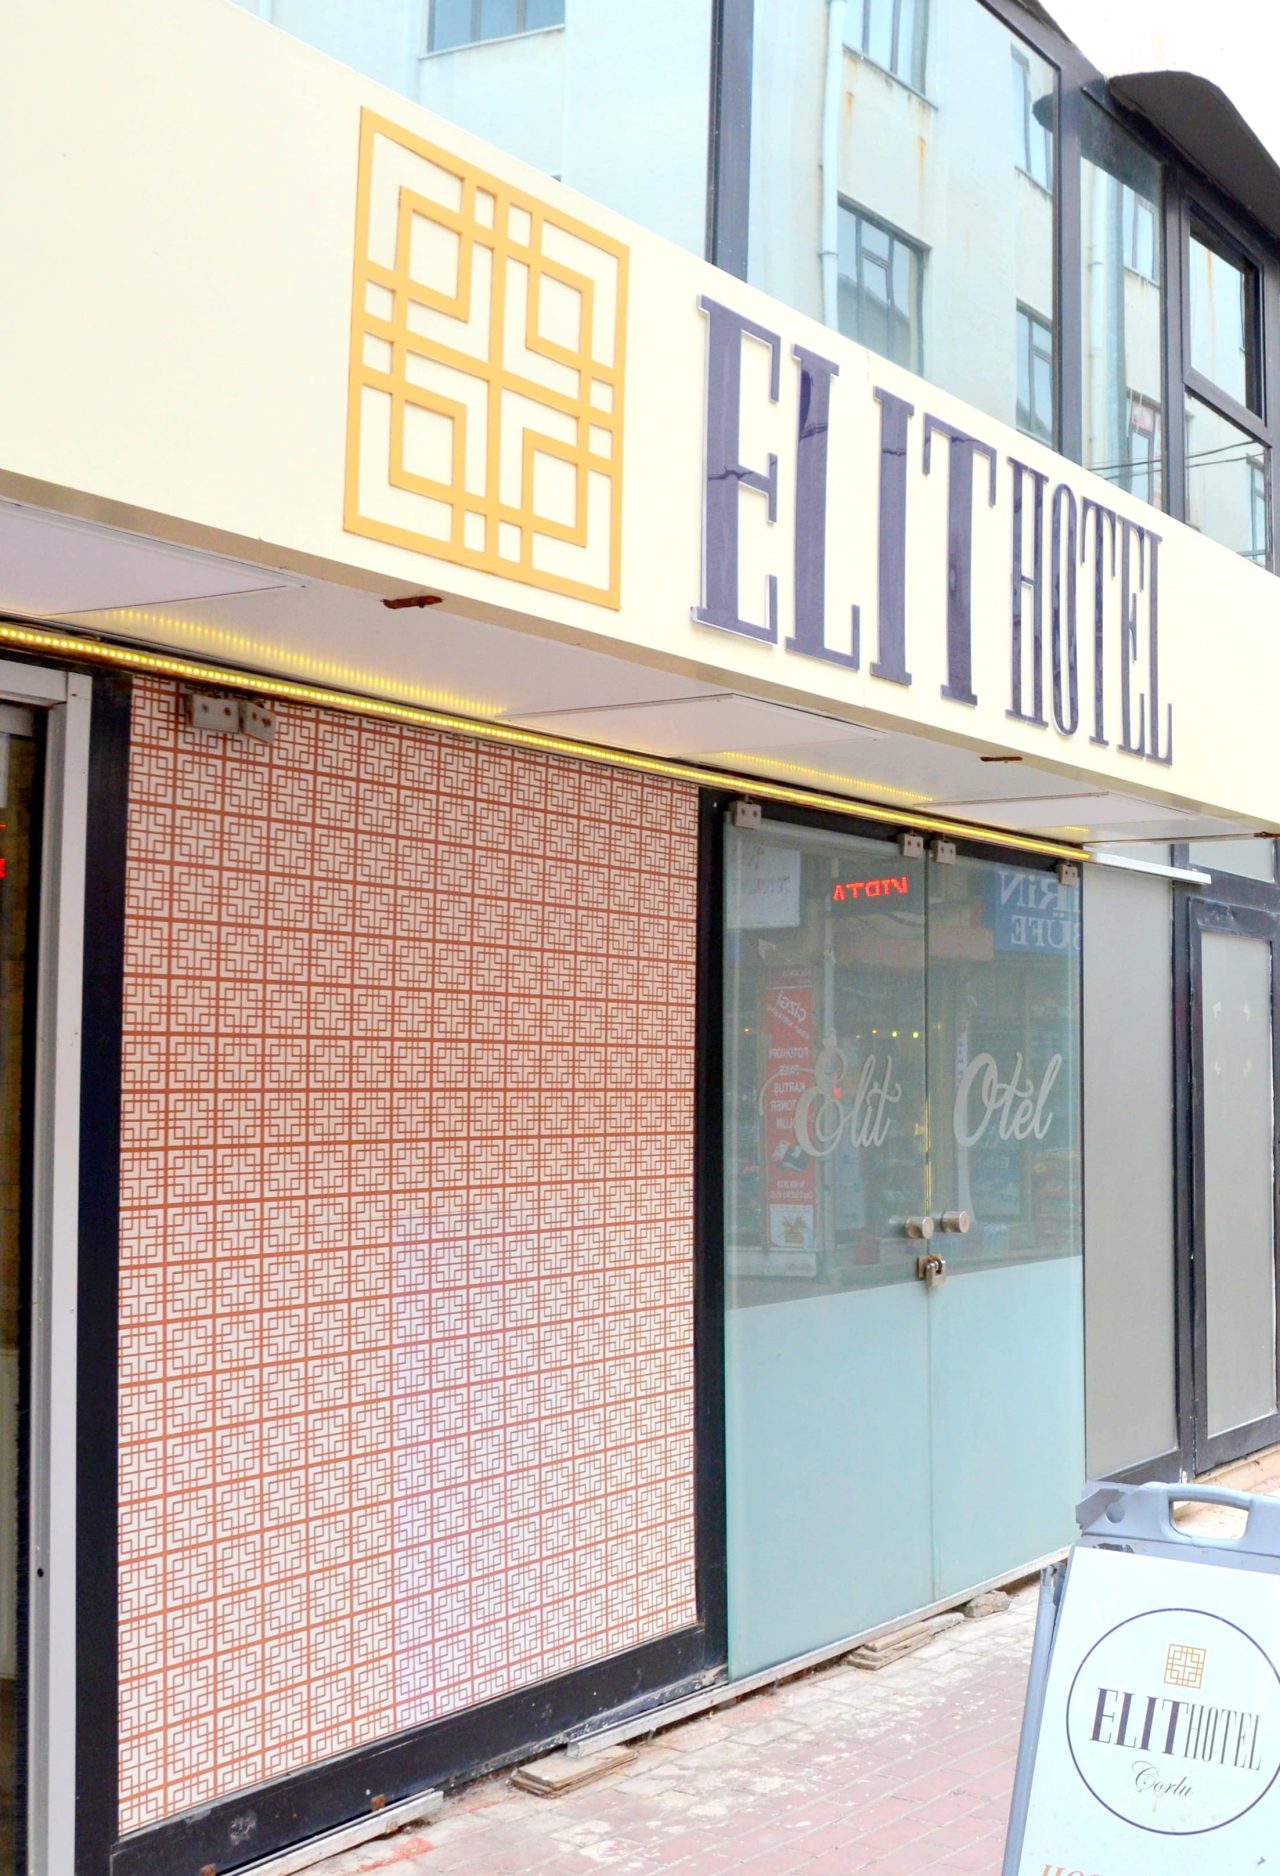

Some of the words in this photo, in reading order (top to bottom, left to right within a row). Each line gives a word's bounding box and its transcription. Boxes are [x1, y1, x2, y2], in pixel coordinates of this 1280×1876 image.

[691, 294, 998, 707] ELIT
[1005, 456, 1173, 766] HOTEL
[758, 1046, 901, 1158] Elit
[952, 1051, 1062, 1148] Otel
[1089, 1687, 1189, 1757] ELIT
[1184, 1704, 1263, 1772] HOTEL
[1131, 1760, 1193, 1799] Çorlu
